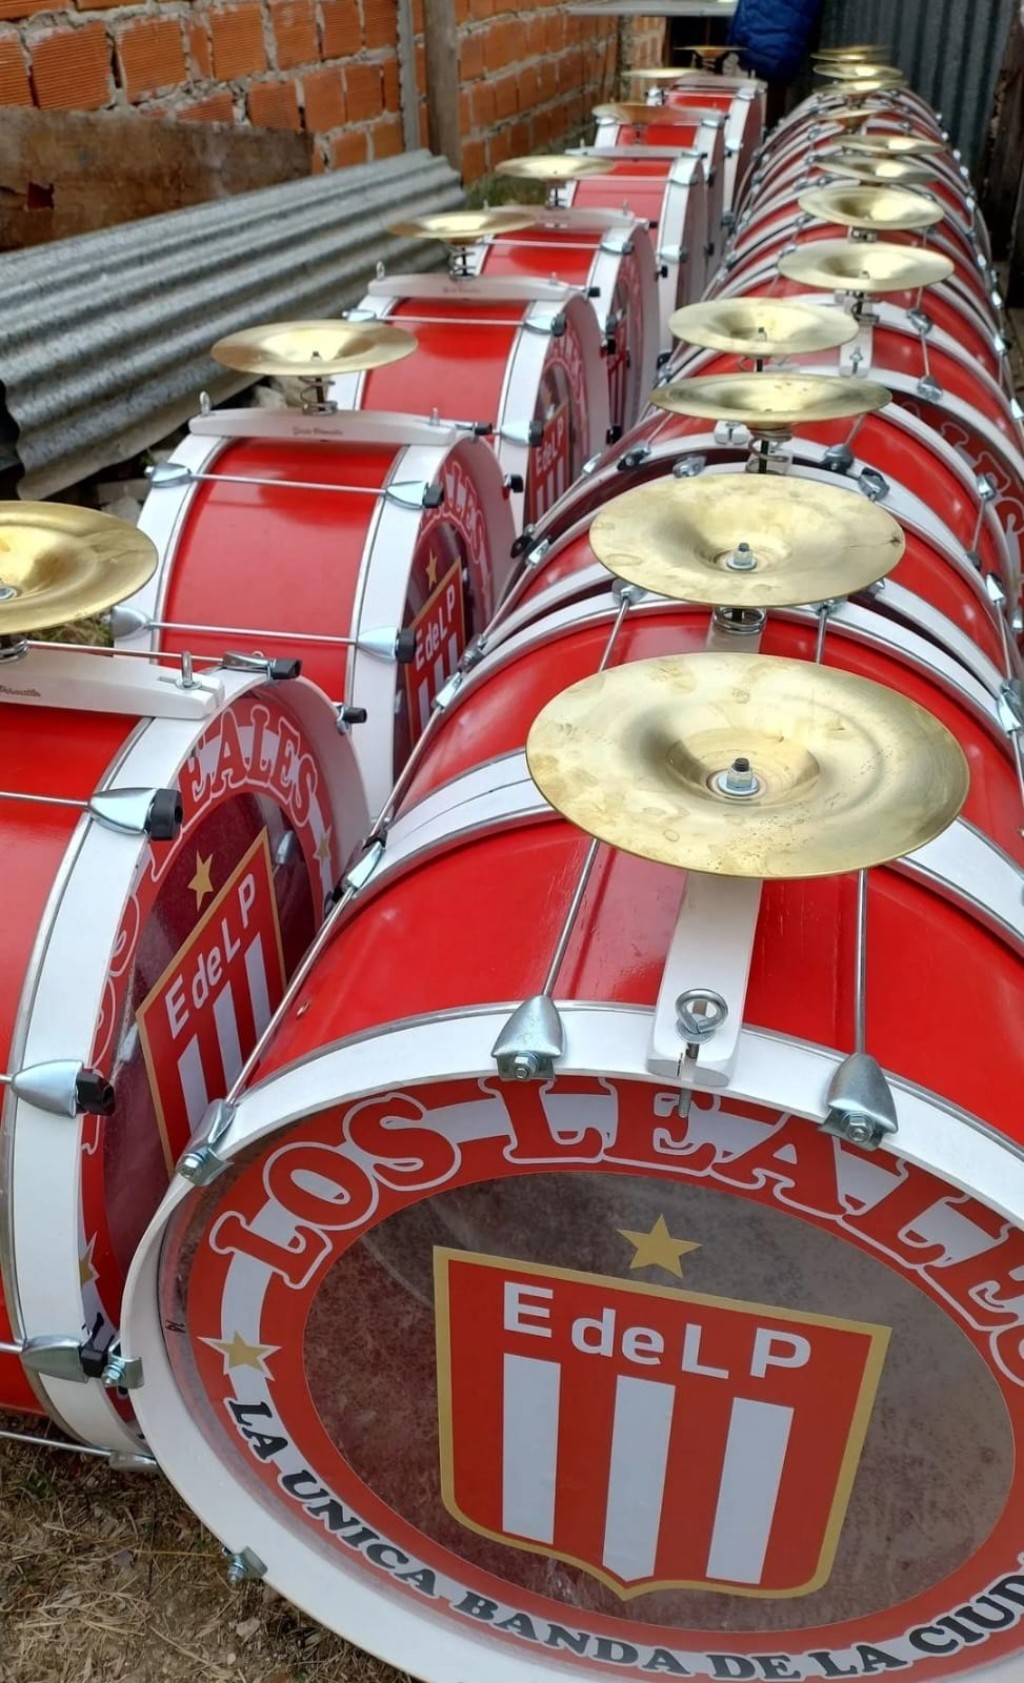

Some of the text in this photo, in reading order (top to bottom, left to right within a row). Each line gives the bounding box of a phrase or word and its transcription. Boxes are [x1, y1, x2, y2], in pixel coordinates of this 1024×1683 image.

[415, 584, 456, 672] EdeLP
[165, 873, 256, 1039] EdeLP
[209, 1092, 462, 1290] LOS
[503, 1281, 812, 1380] EdeLP
[227, 1399, 289, 1460] LA
[281, 1469, 437, 1597] UNICA
[453, 1590, 691, 1675] BANDA
[705, 1653, 801, 1680] DE
[807, 1644, 908, 1677] LA
